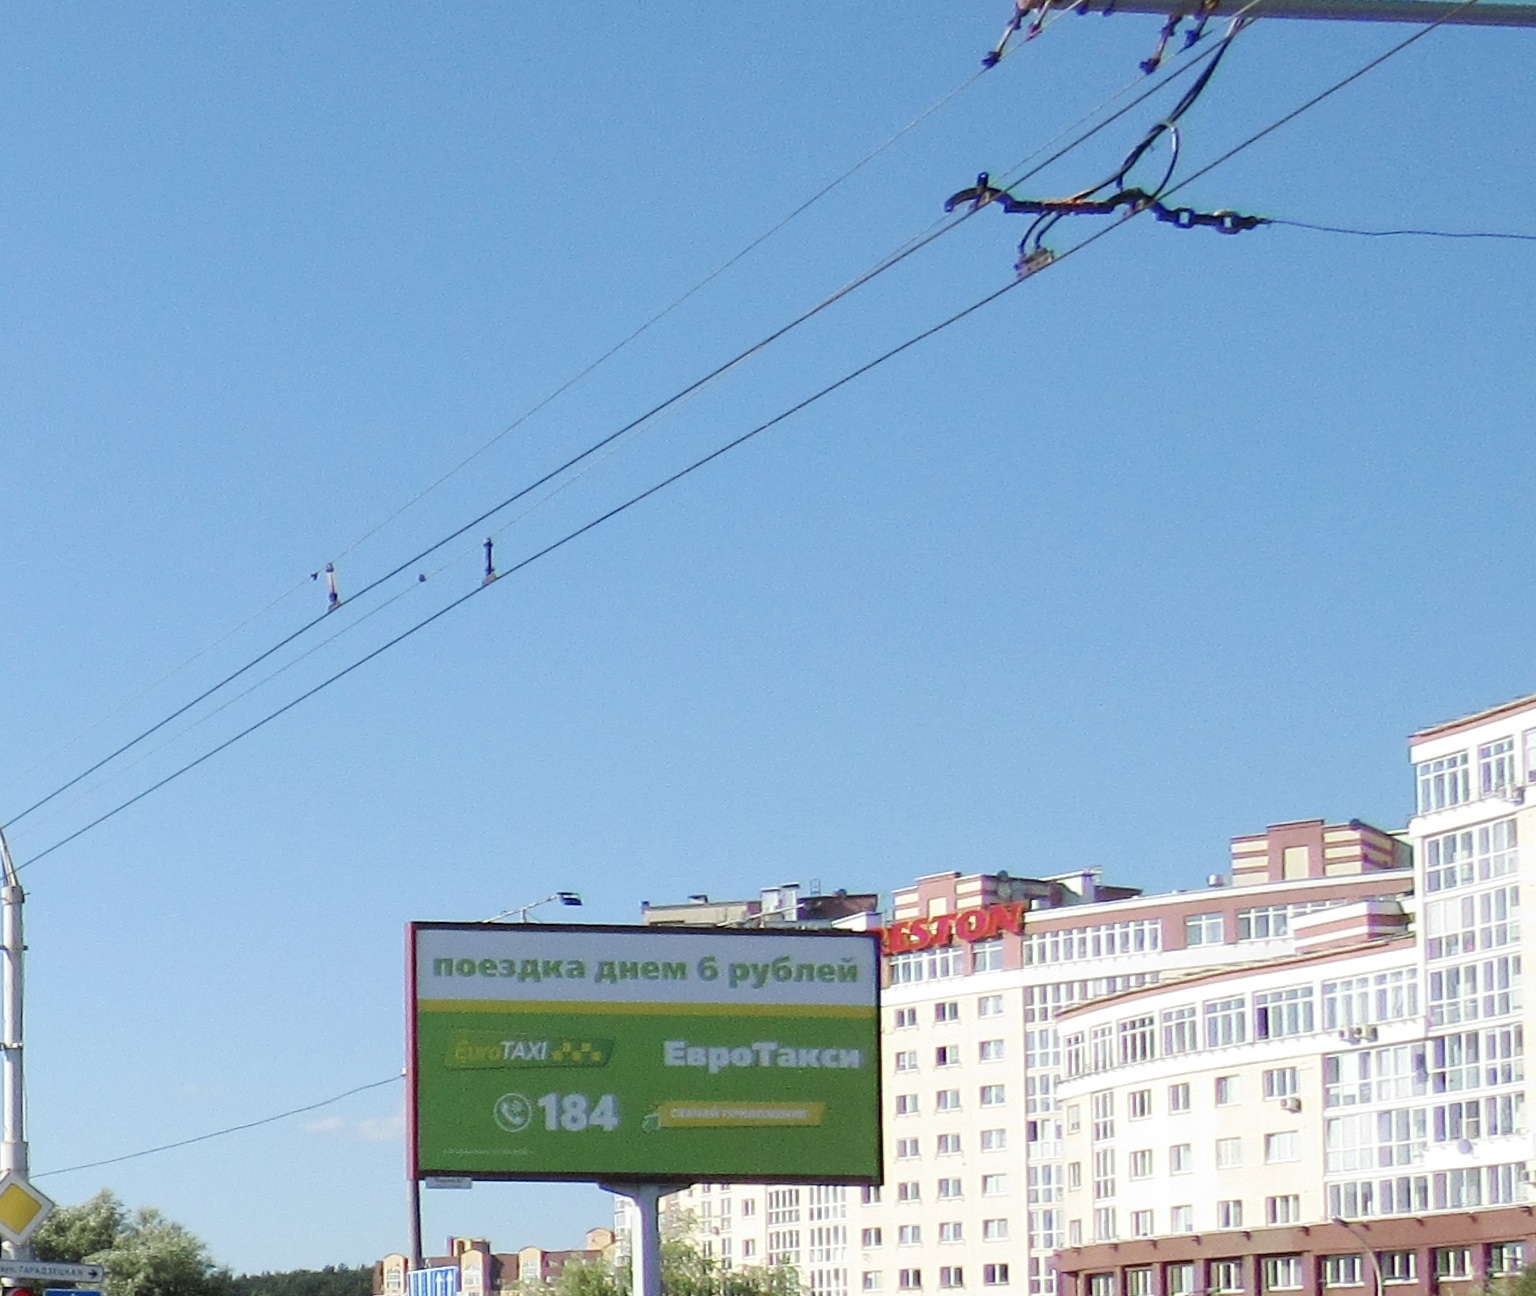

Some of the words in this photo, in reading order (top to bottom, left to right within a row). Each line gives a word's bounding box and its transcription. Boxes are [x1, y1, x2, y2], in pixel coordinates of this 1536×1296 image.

[433, 957, 586, 983] поездка
[594, 959, 688, 984] днем
[696, 955, 719, 981] 6
[728, 955, 858, 989] рублей
[663, 1040, 863, 1074] ЕвроТакси
[537, 1092, 620, 1131] 184
